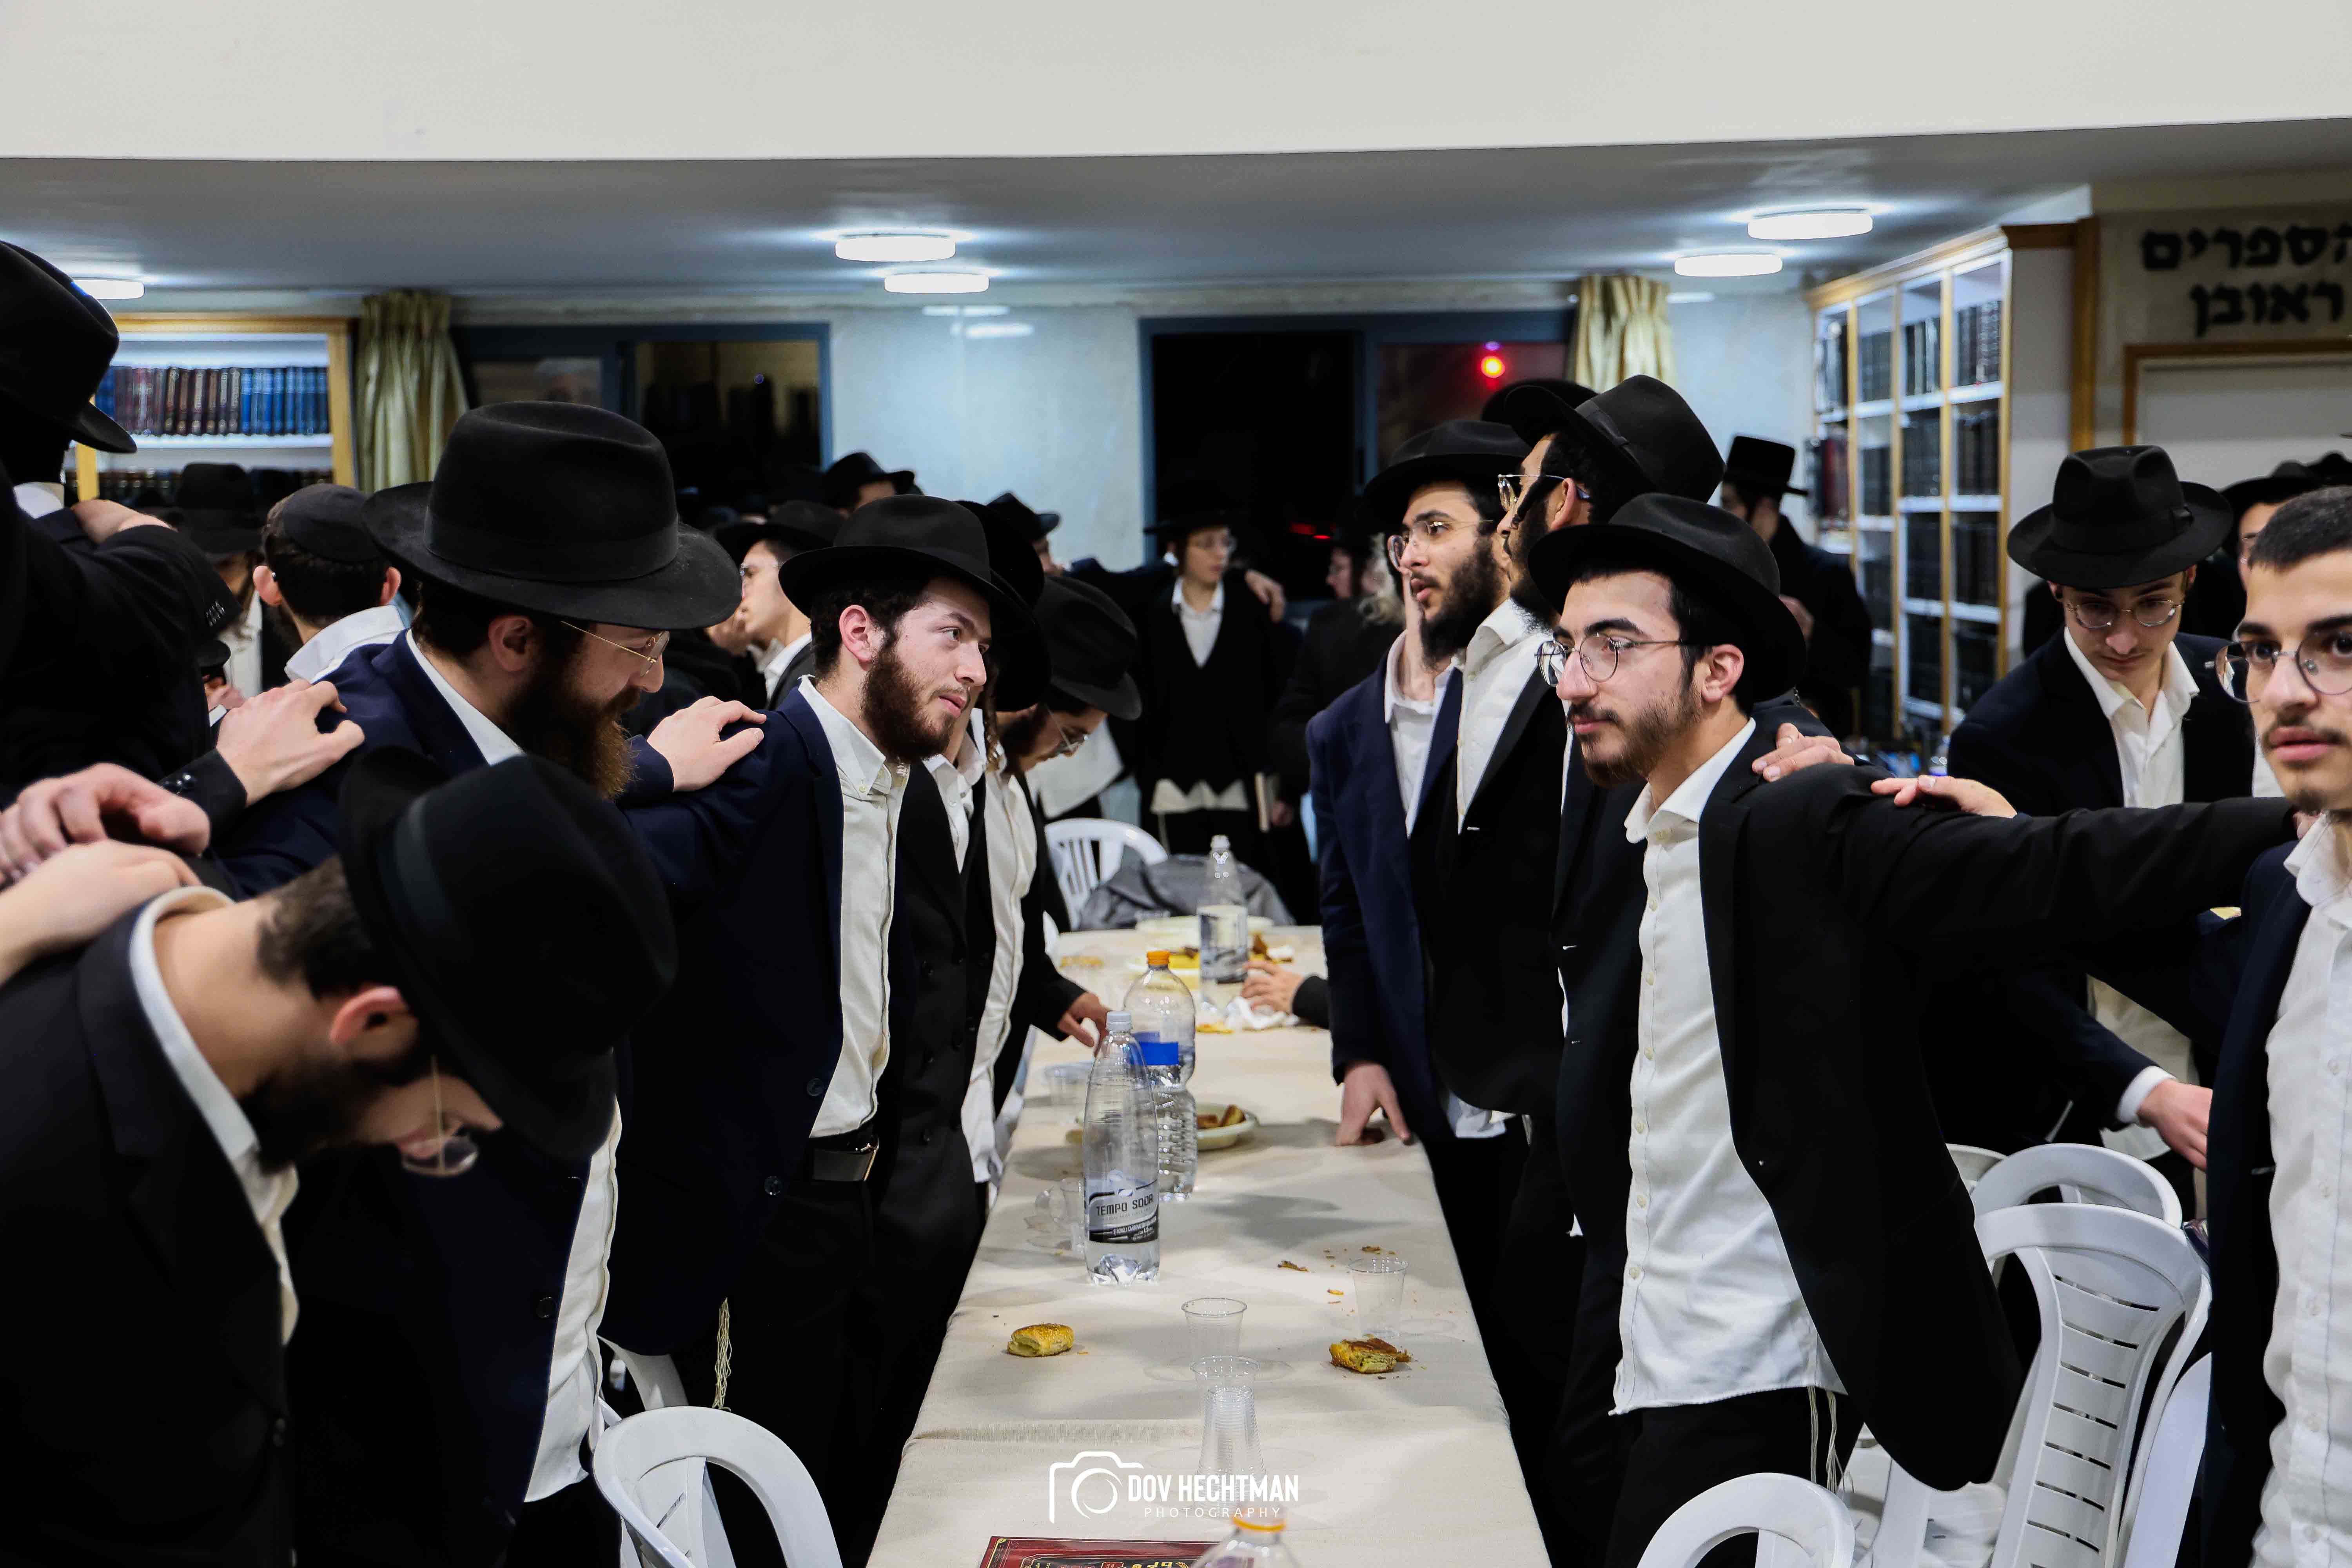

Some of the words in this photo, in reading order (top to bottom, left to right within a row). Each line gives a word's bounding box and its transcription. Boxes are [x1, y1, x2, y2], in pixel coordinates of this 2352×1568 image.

[2189, 279, 2346, 338] ראובן
[1096, 1202, 1128, 1216] TEMPO
[1132, 1193, 1153, 1210] SODA
